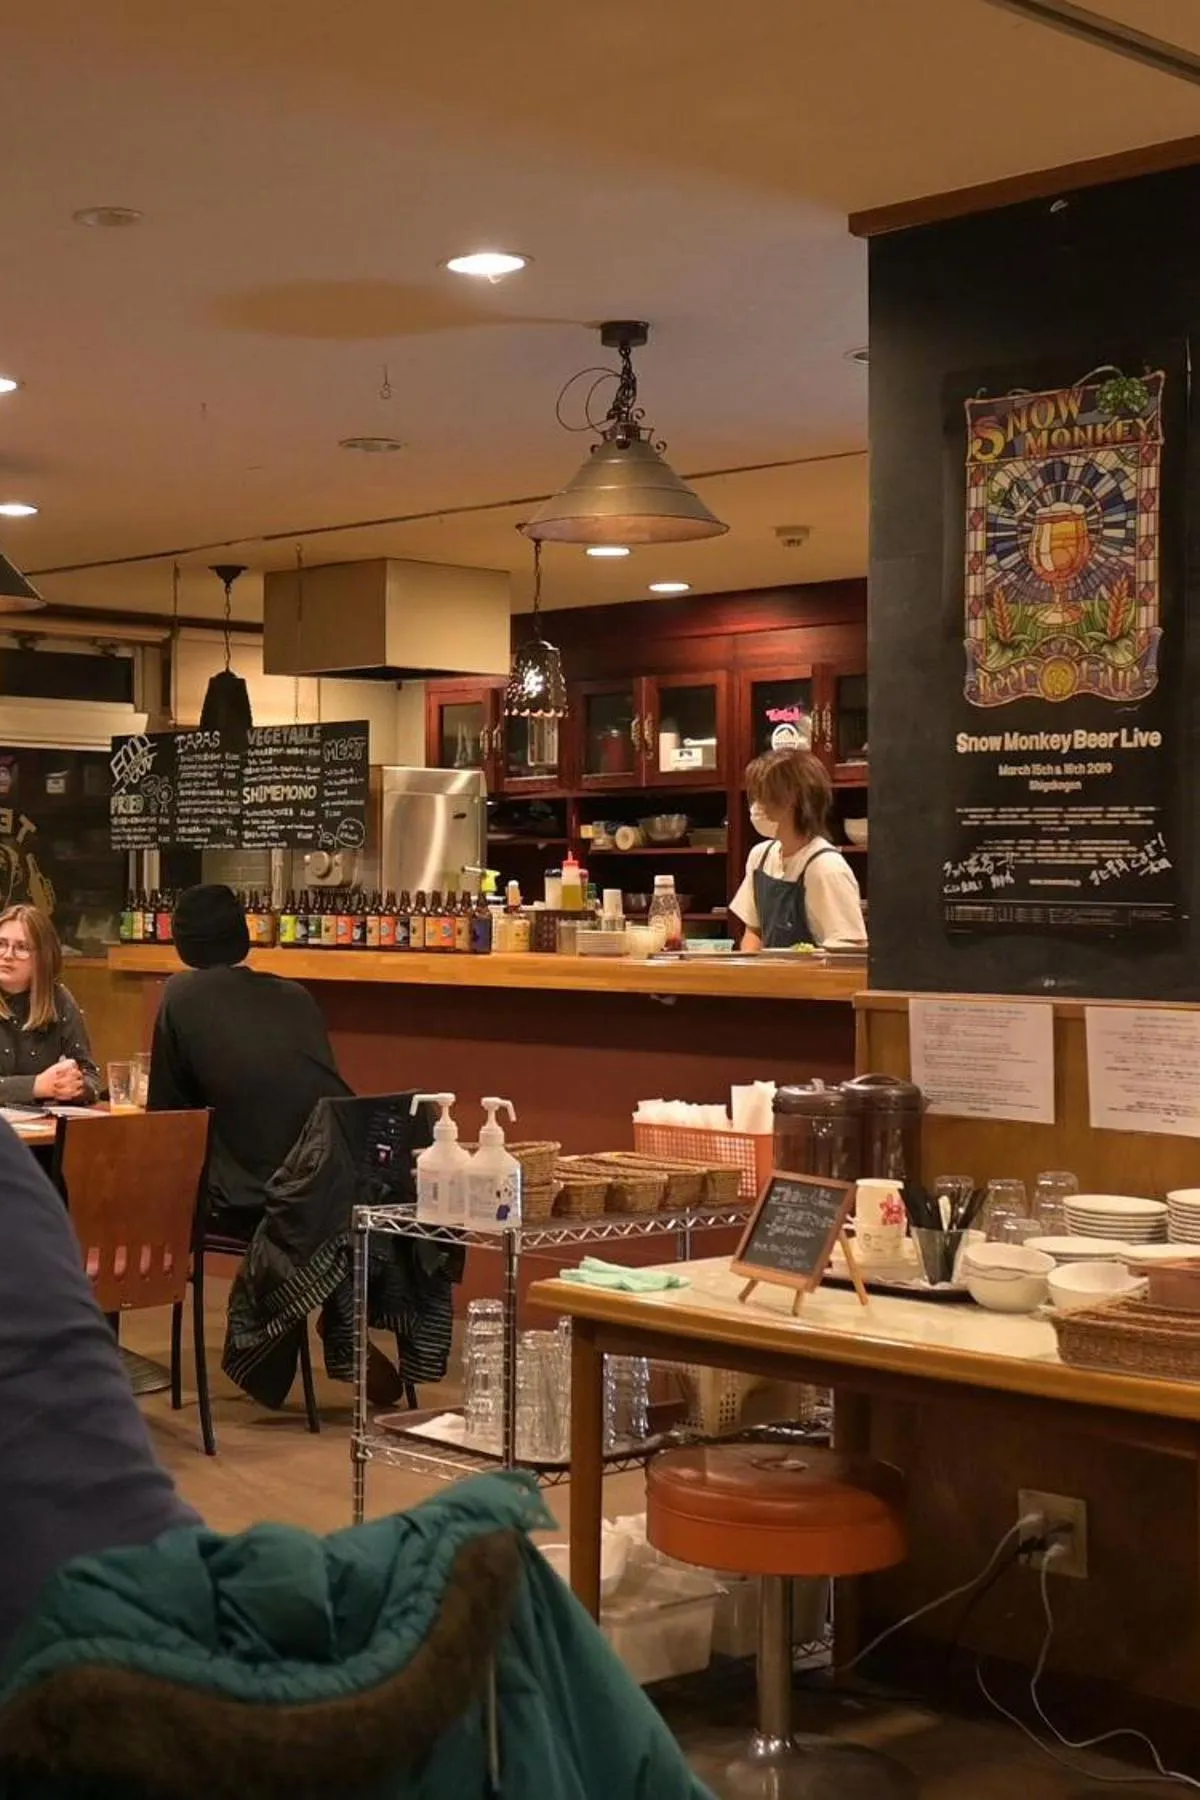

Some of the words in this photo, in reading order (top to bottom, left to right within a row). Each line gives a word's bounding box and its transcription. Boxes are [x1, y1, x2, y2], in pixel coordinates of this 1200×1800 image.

[972, 387, 1085, 462] SNOW
[1024, 410, 1157, 459] MONKEY
[175, 730, 221, 753] TAPAS
[247, 726, 321, 747] VEGETABLE
[956, 732, 1002, 753] Snow
[1004, 730, 1072, 754] Monkey
[1073, 729, 1119, 749] Beer
[1121, 727, 1162, 748] Live
[998, 764, 1030, 776] March
[242, 785, 317, 805] SHIMEMONO
